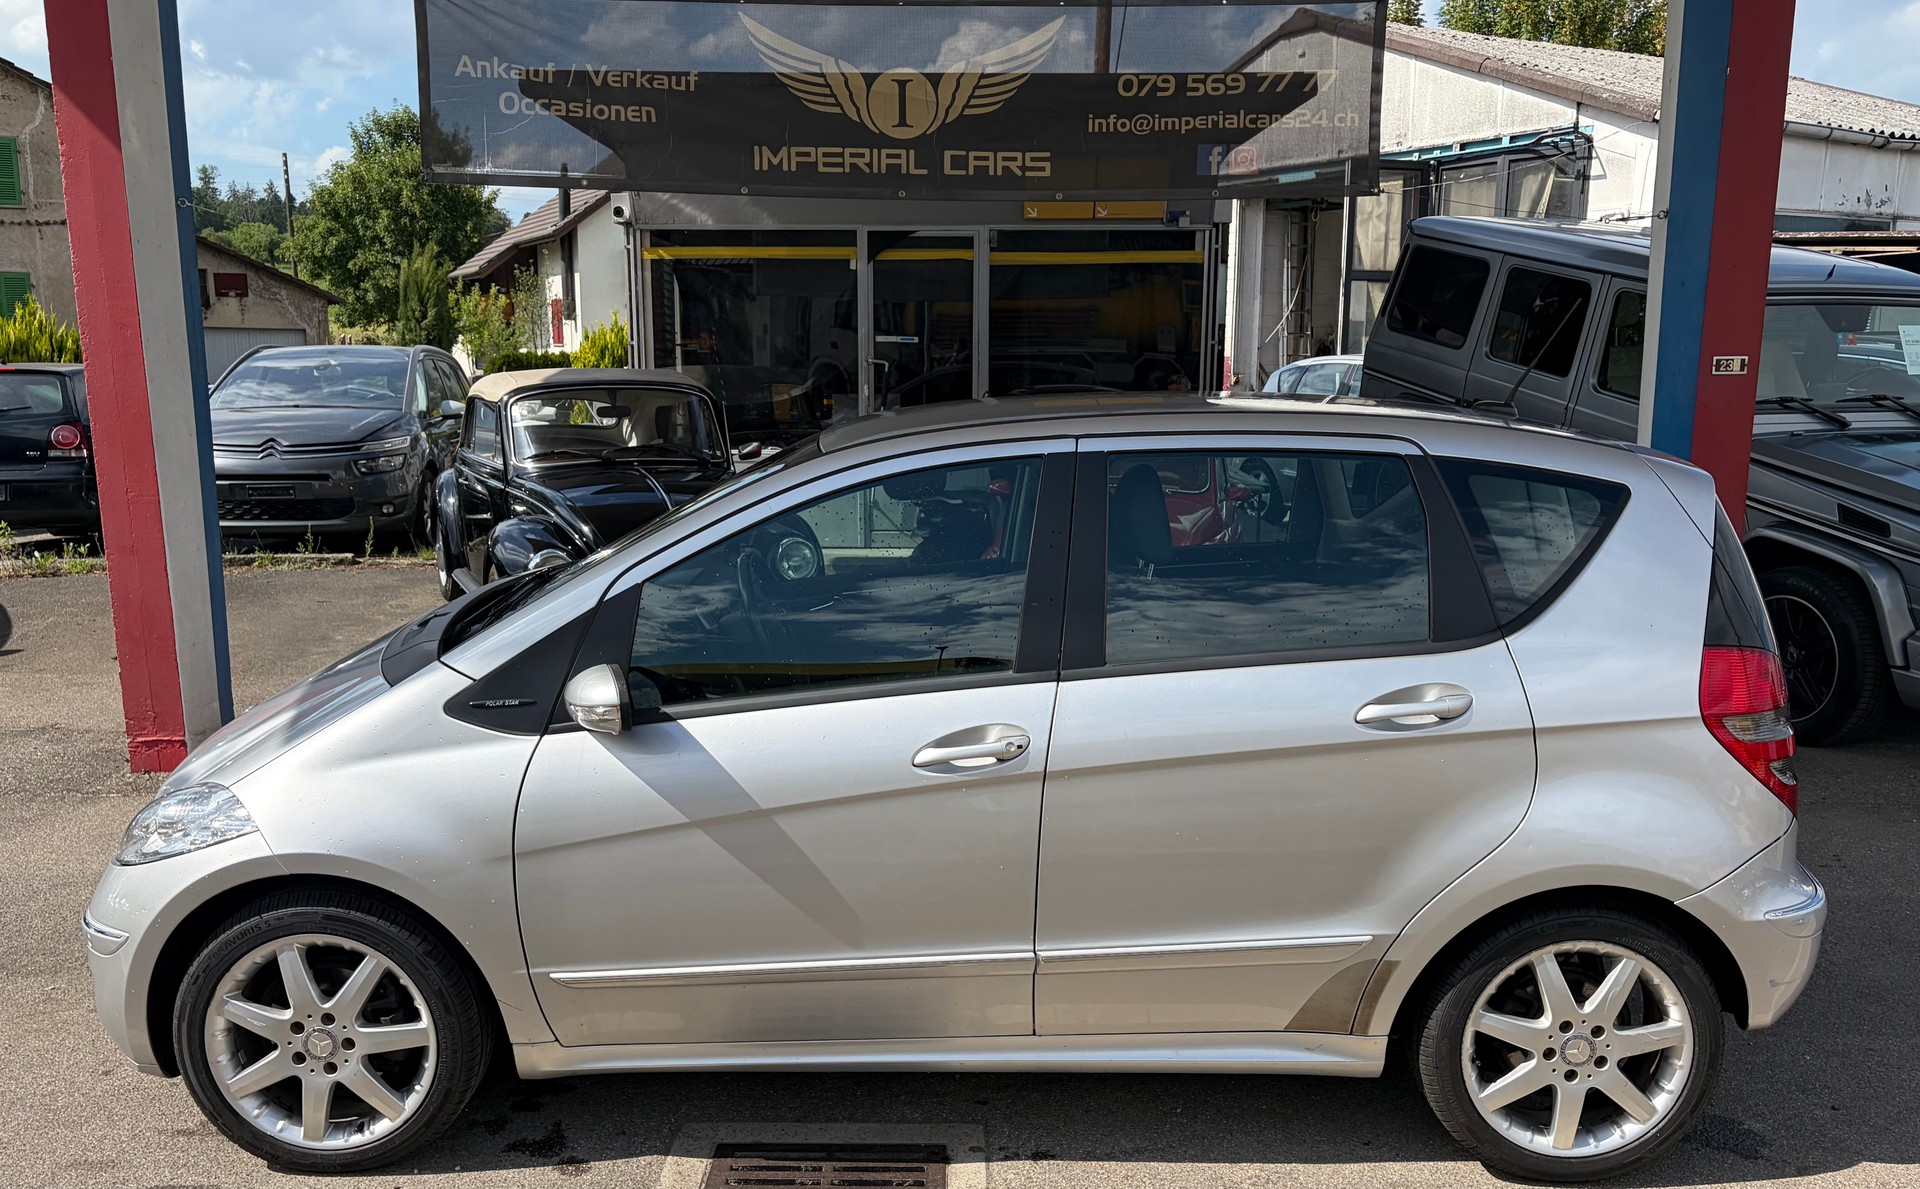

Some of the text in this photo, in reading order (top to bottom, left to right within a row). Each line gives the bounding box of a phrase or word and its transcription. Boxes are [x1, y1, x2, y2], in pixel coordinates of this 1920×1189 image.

[454, 54, 699, 92] Ankauf / Verkauf
[1117, 69, 1340, 98] 079 569 77 77
[500, 91, 657, 123] Occasionen
[1088, 109, 1360, 135] info@imperialcars24.ch
[753, 145, 1052, 177] IMPERIAL CARS
[211, 923, 263, 960] BRAVURIS
